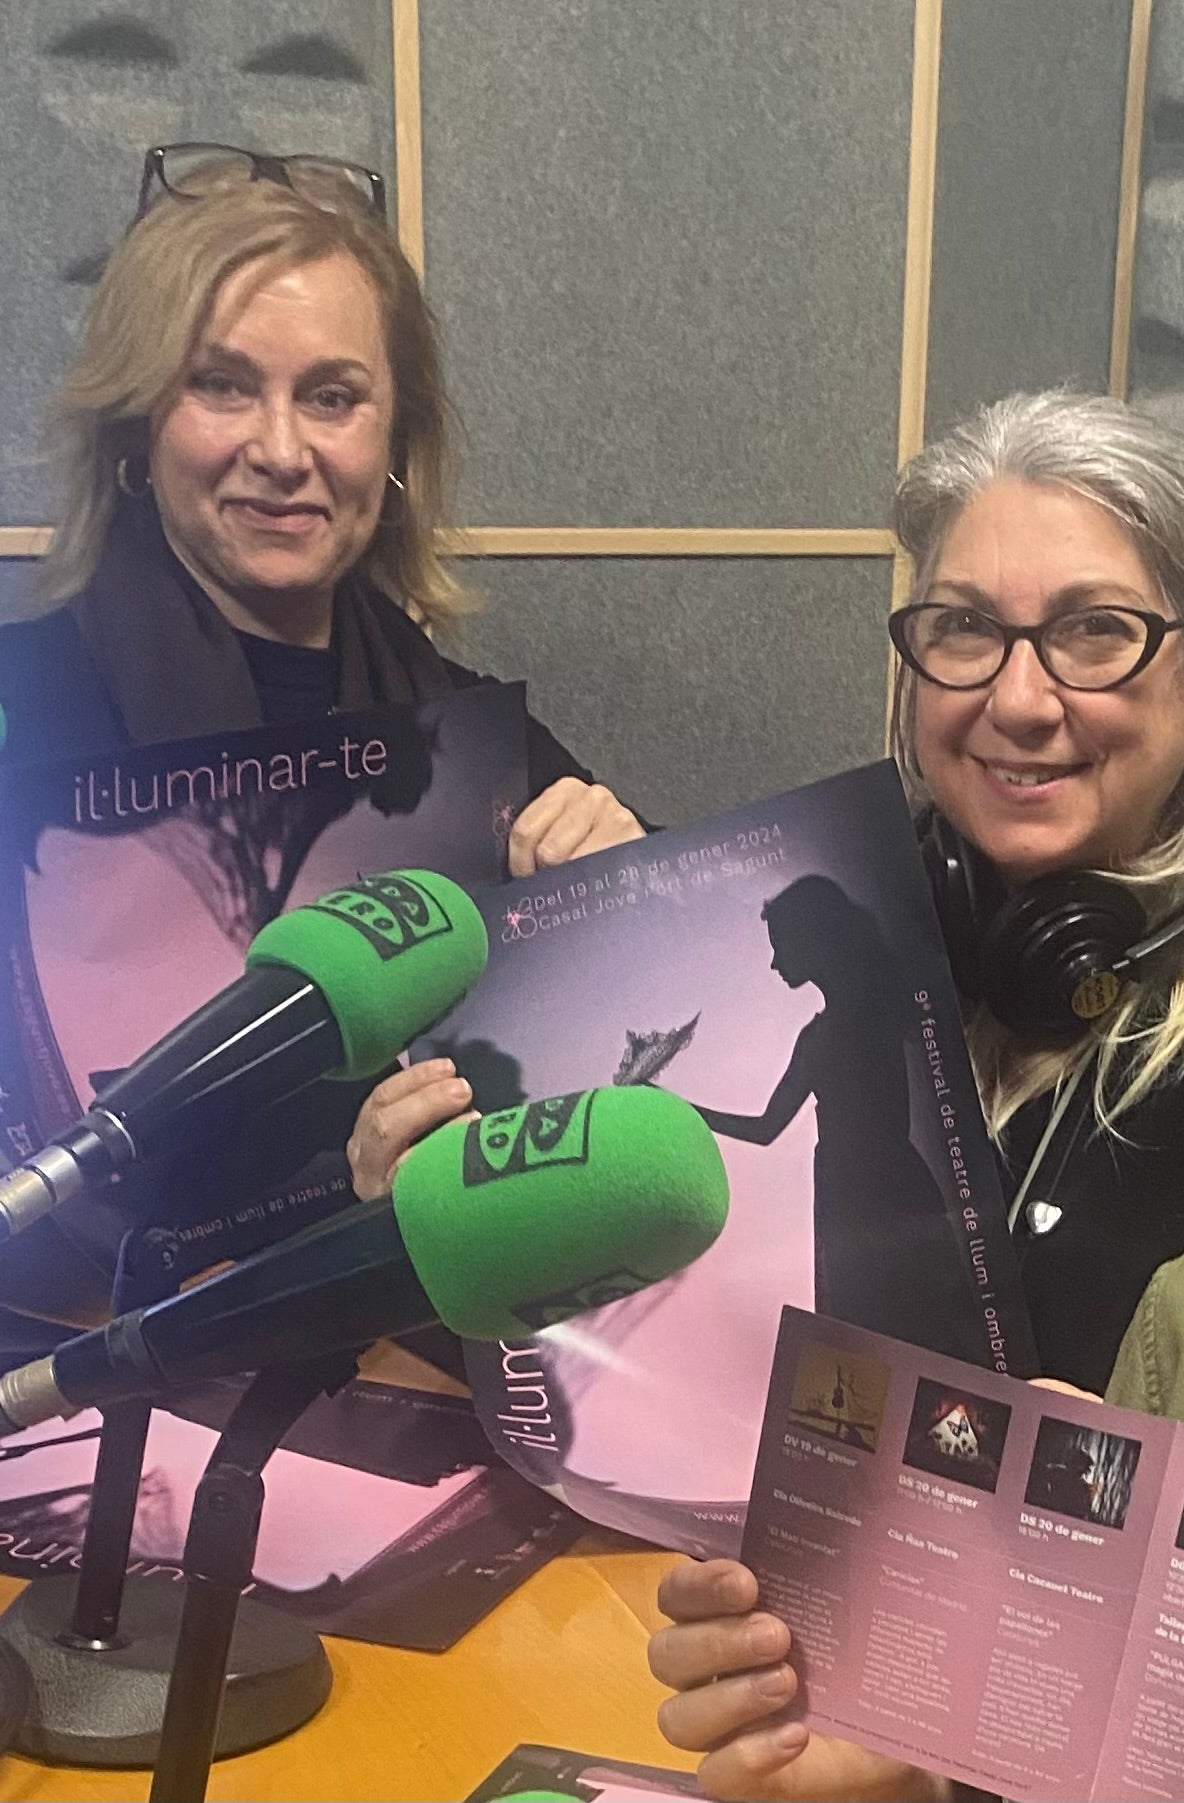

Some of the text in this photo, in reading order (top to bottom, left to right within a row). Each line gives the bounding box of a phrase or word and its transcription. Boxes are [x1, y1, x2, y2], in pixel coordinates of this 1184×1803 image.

[534, 892, 563, 912] Del
[570, 882, 588, 898] 19
[595, 873, 611, 891] al
[678, 841, 731, 871] gener
[737, 822, 783, 851] 2024
[537, 904, 587, 931] Casal
[595, 892, 637, 915] Jove
[690, 869, 713, 886] de
[721, 847, 786, 878] Sagunt
[921, 1017, 951, 1099] festival
[940, 1104, 956, 1129] de
[947, 1136, 971, 1199] teatre
[963, 1206, 979, 1232] de
[970, 1238, 989, 1286] llum
[984, 1306, 1009, 1376] ombre
[931, 1485, 946, 1498] de
[946, 1490, 978, 1510] gener
[888, 1527, 905, 1541] Cia
[1020, 1512, 1105, 1549] DS 20 de gener
[1009, 1567, 1026, 1581] Cia
[1155, 1625, 1169, 1638] de
[1169, 1630, 1181, 1642] la
